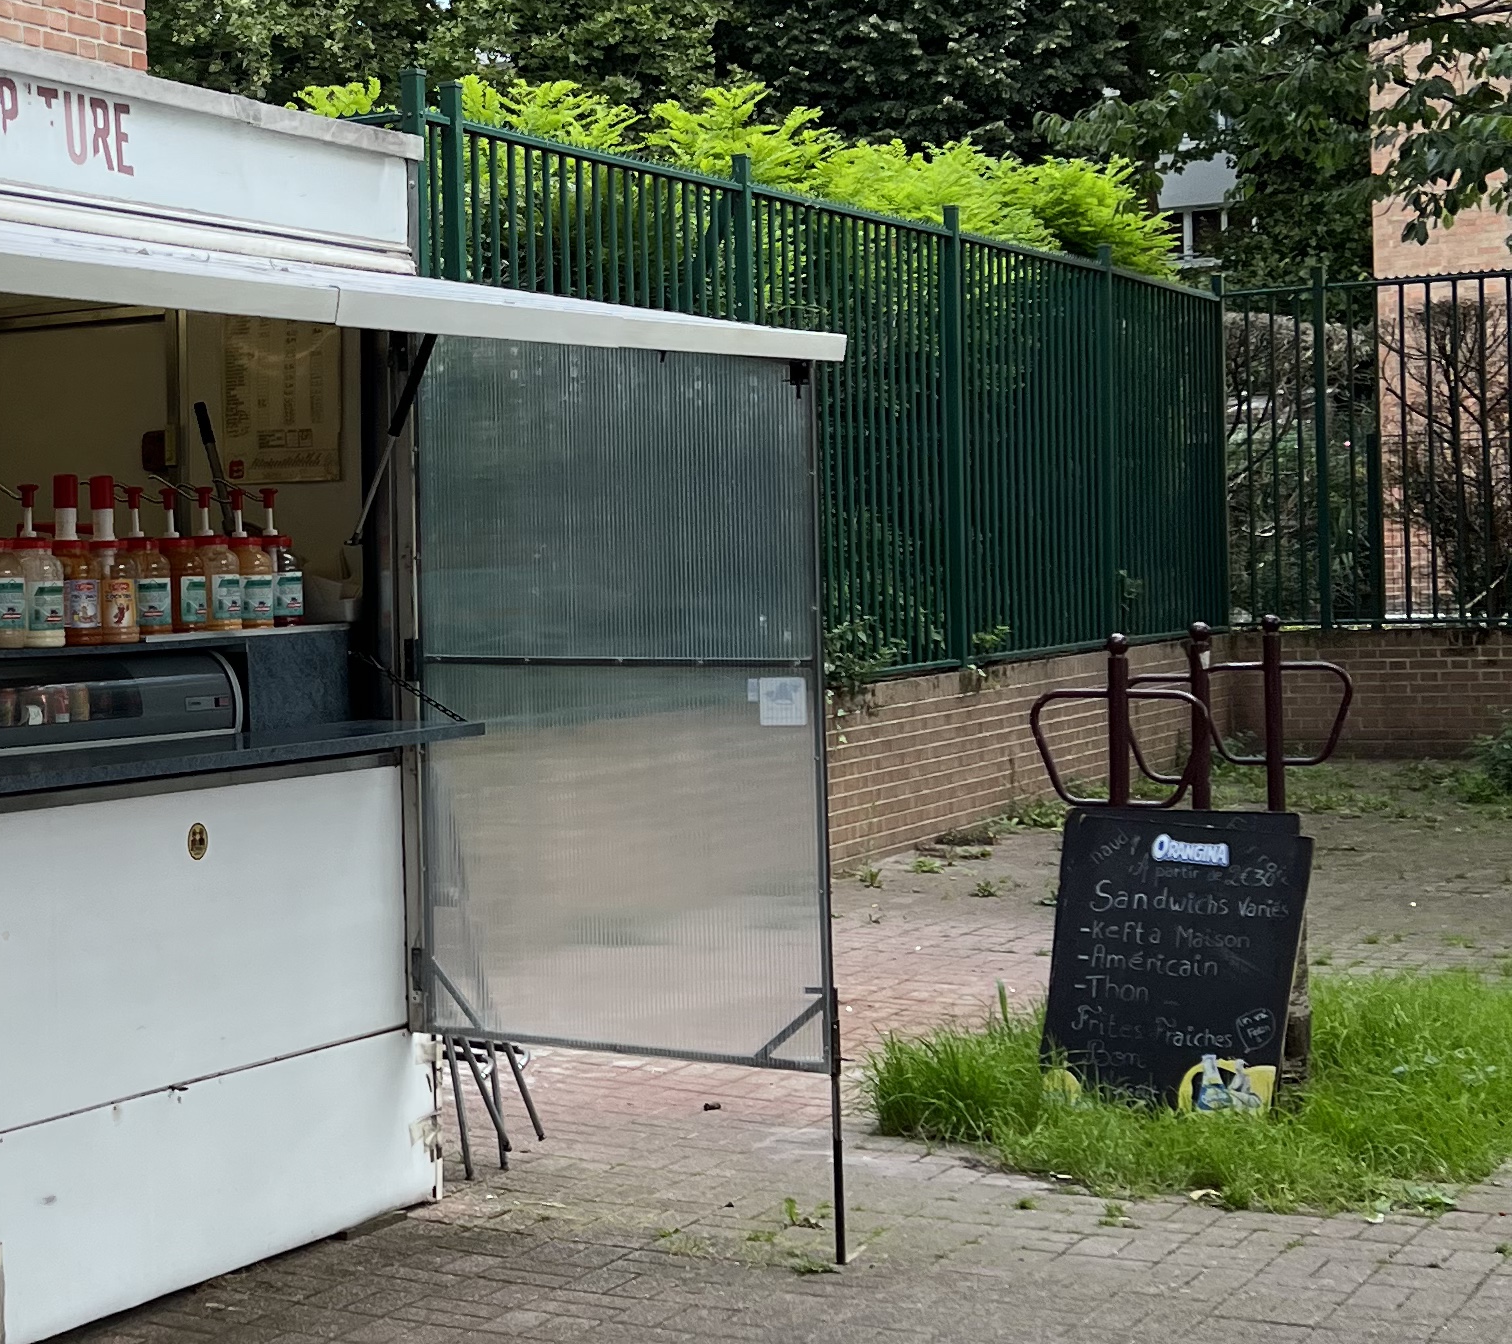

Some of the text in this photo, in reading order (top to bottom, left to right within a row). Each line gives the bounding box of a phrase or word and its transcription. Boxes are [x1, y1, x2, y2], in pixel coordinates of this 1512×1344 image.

[1152, 833, 1230, 867] ORANGINA
[1155, 865, 1199, 886] partir
[1090, 879, 1229, 915] Sandwichs
[1175, 925, 1250, 948] Maison
[1071, 1005, 1143, 1039] Frites
